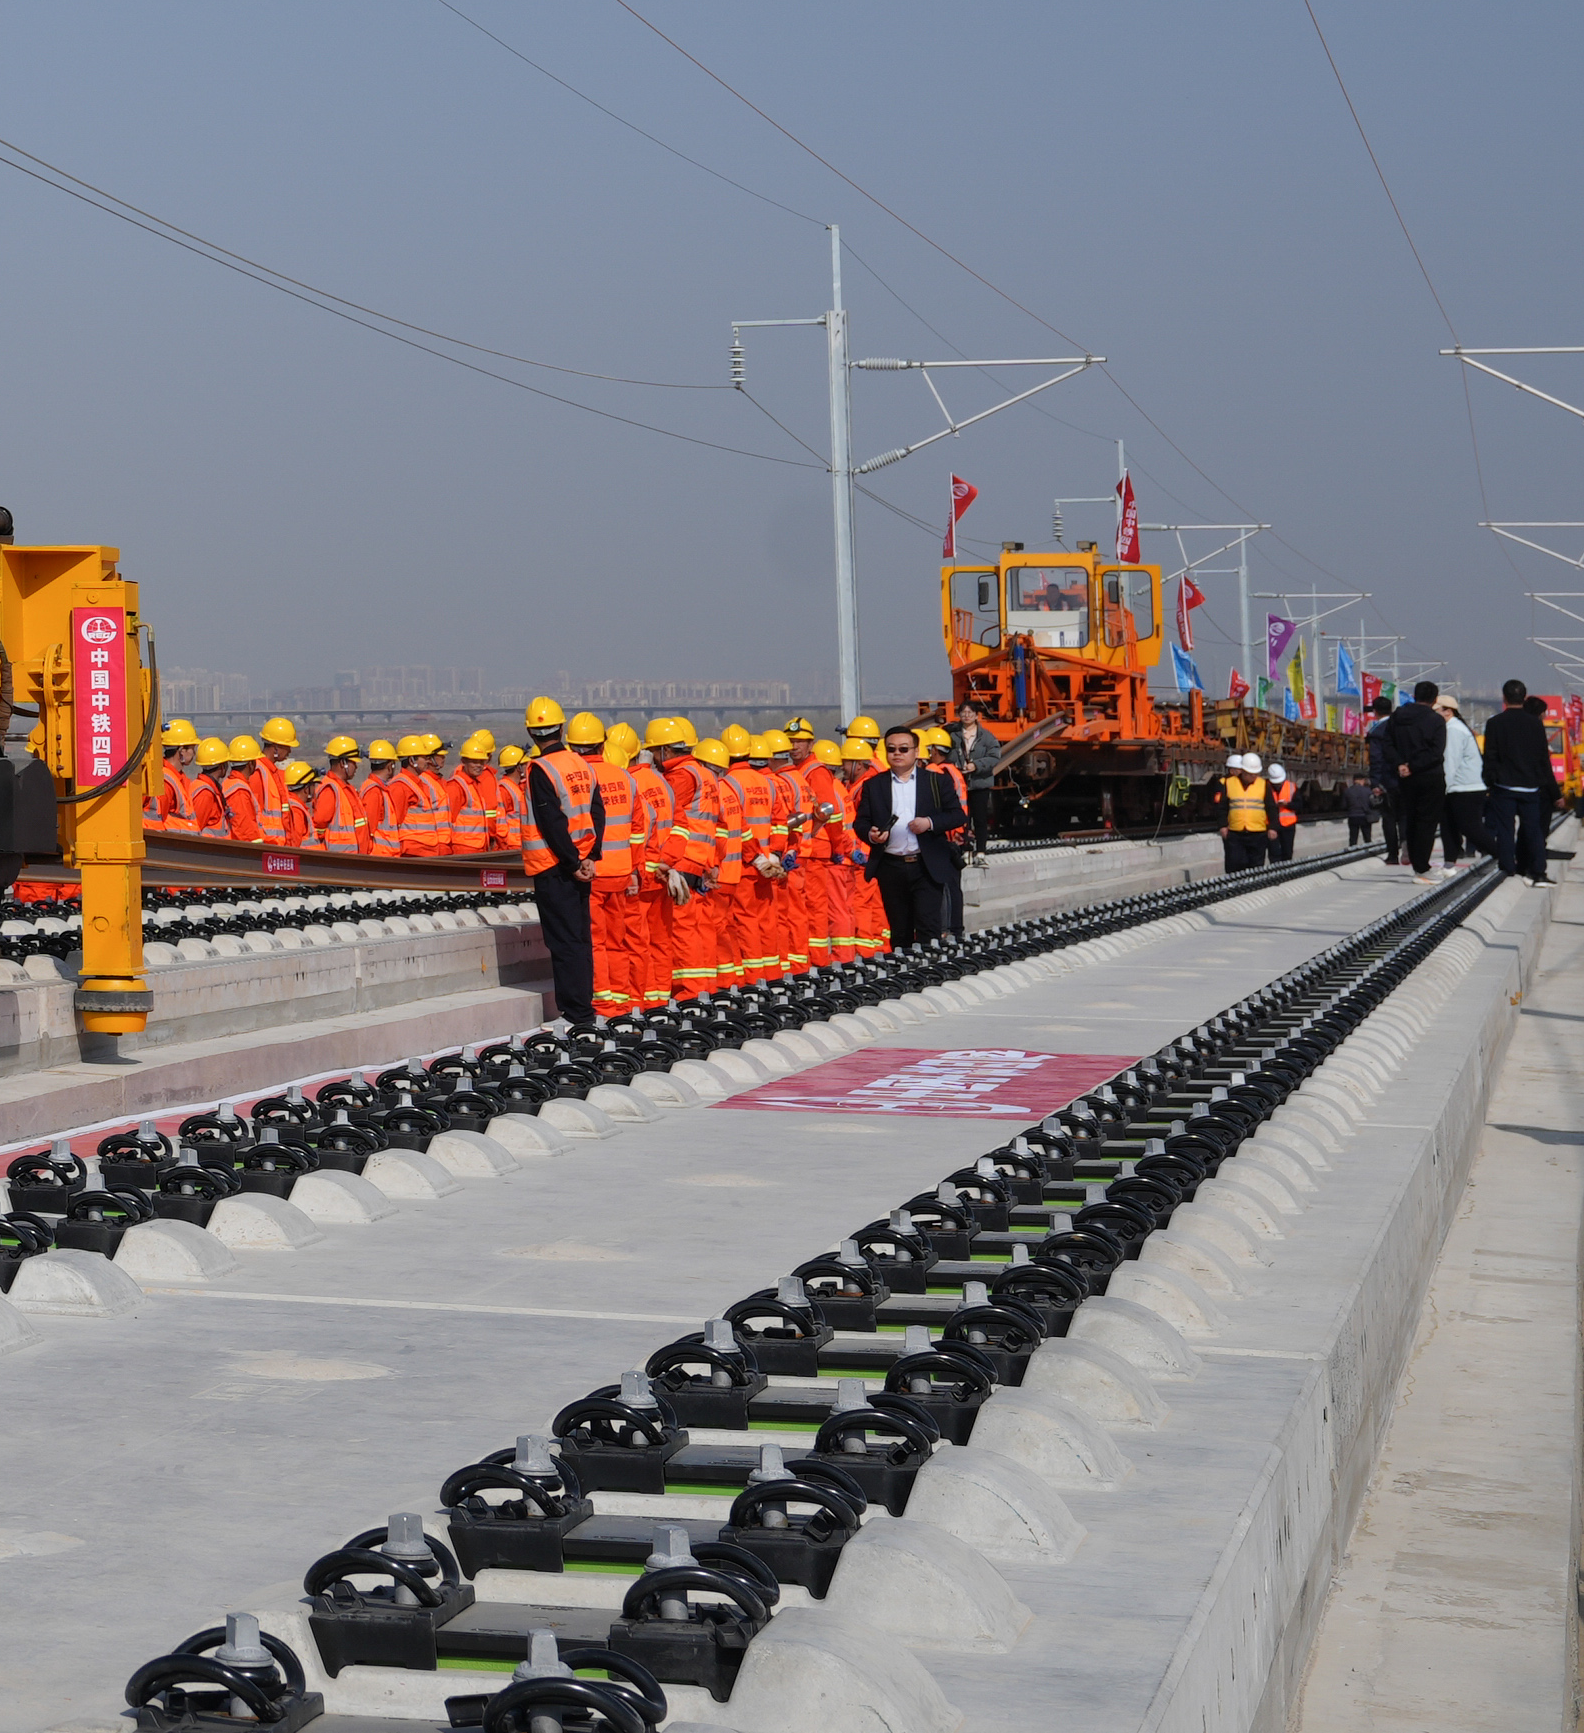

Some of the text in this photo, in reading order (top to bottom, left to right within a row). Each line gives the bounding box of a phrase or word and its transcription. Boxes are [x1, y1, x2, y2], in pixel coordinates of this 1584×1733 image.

[91, 648, 112, 777] 中国中铁四局
